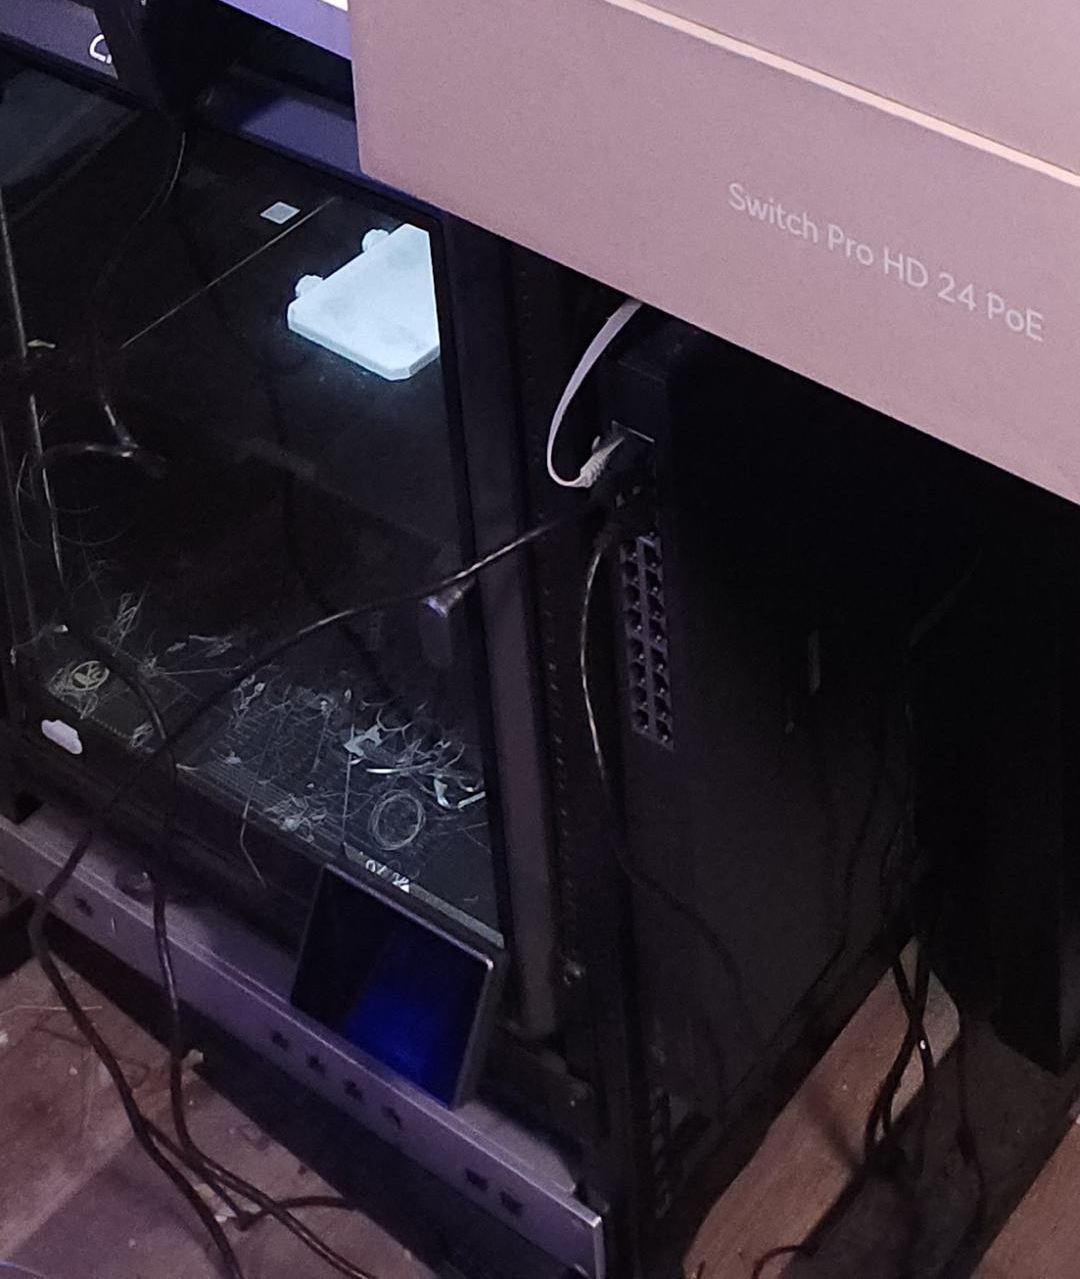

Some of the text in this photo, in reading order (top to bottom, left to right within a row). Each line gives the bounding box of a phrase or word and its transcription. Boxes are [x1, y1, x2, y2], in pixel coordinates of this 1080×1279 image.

[728, 183, 1045, 342] Switch Pro HD 24 PoE
